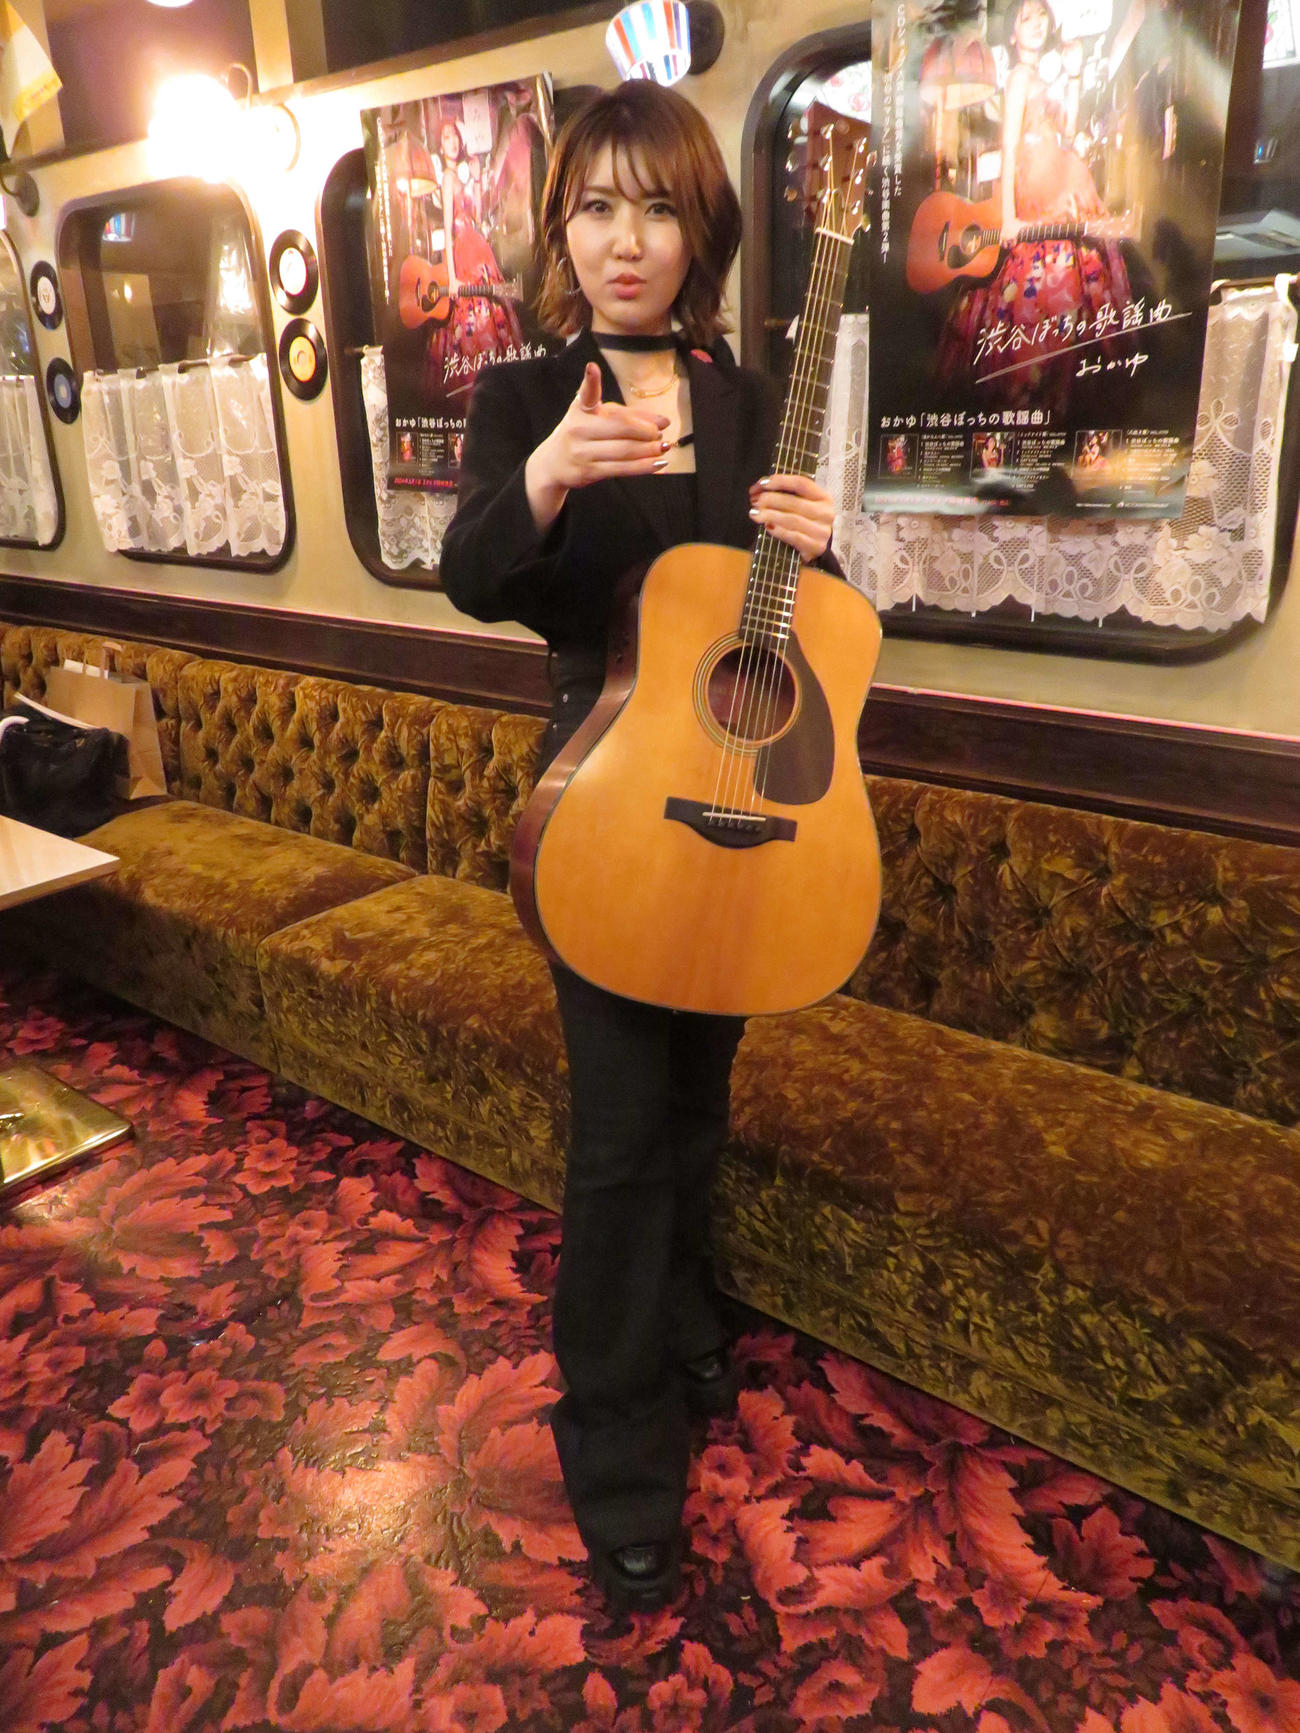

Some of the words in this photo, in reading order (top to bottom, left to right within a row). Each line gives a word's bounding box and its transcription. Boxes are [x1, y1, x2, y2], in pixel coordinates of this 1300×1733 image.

[973, 296, 1173, 366] 渋谷ぼっちの歌謡曲
[1075, 352, 1149, 378] おかゆ
[395, 416, 467, 429] おかゆ「渋谷ぼっちの
